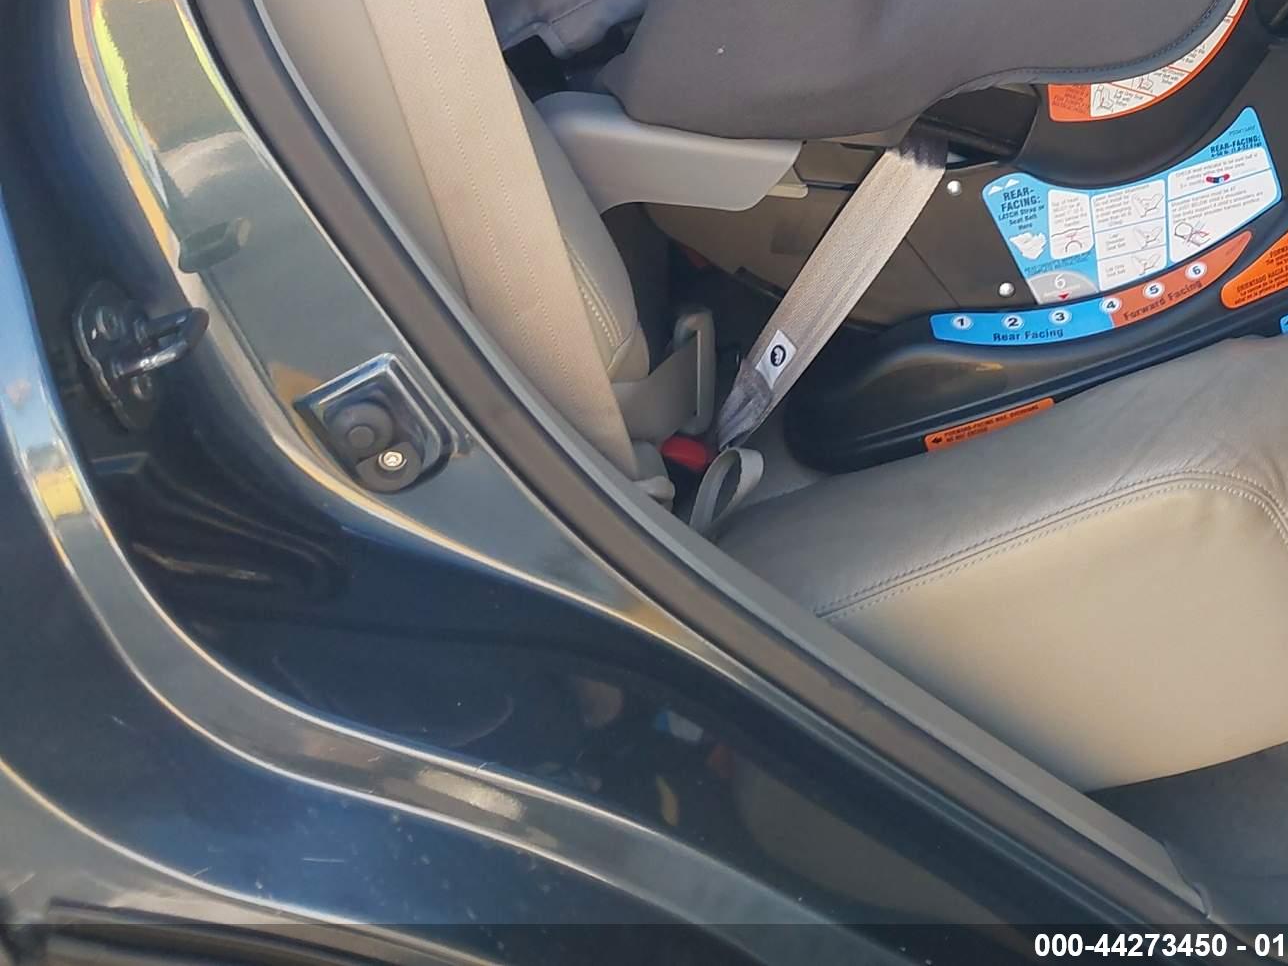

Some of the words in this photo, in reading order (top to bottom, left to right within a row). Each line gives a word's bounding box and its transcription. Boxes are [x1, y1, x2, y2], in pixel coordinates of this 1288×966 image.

[1003, 187, 1034, 201] REAR-
[1001, 195, 1041, 213] FACING:
[1193, 265, 1202, 276] 6
[1054, 274, 1067, 289] 6
[1149, 285, 1160, 296] 5
[1106, 300, 1118, 311] 4
[1123, 297, 1167, 322] Forward
[1167, 280, 1202, 306] Facing
[957, 316, 968, 328] 1
[1007, 317, 1019, 328] 2
[1056, 312, 1066, 323] 3
[993, 331, 1020, 342] Rear
[1025, 328, 1064, 342] Facing
